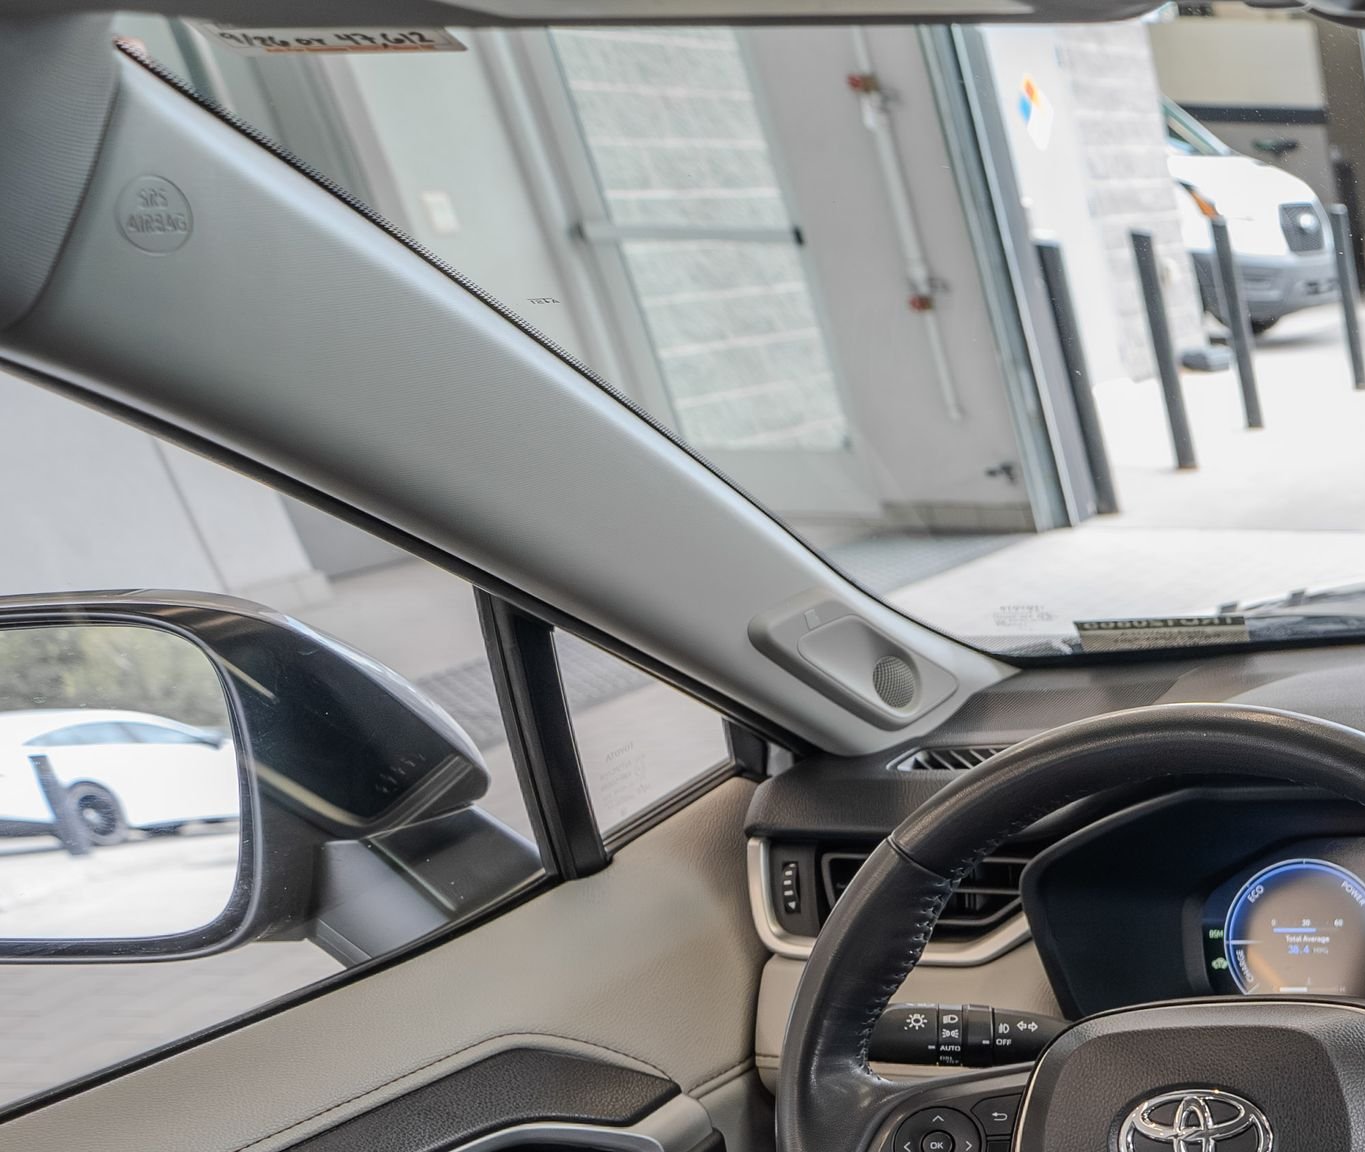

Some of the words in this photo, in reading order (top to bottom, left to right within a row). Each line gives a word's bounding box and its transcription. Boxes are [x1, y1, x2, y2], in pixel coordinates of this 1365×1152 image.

[1247, 884, 1265, 903] ECO
[1341, 880, 1365, 907] POWER
[996, 1038, 1012, 1046] OFF
[930, 1142, 944, 1150] OK
